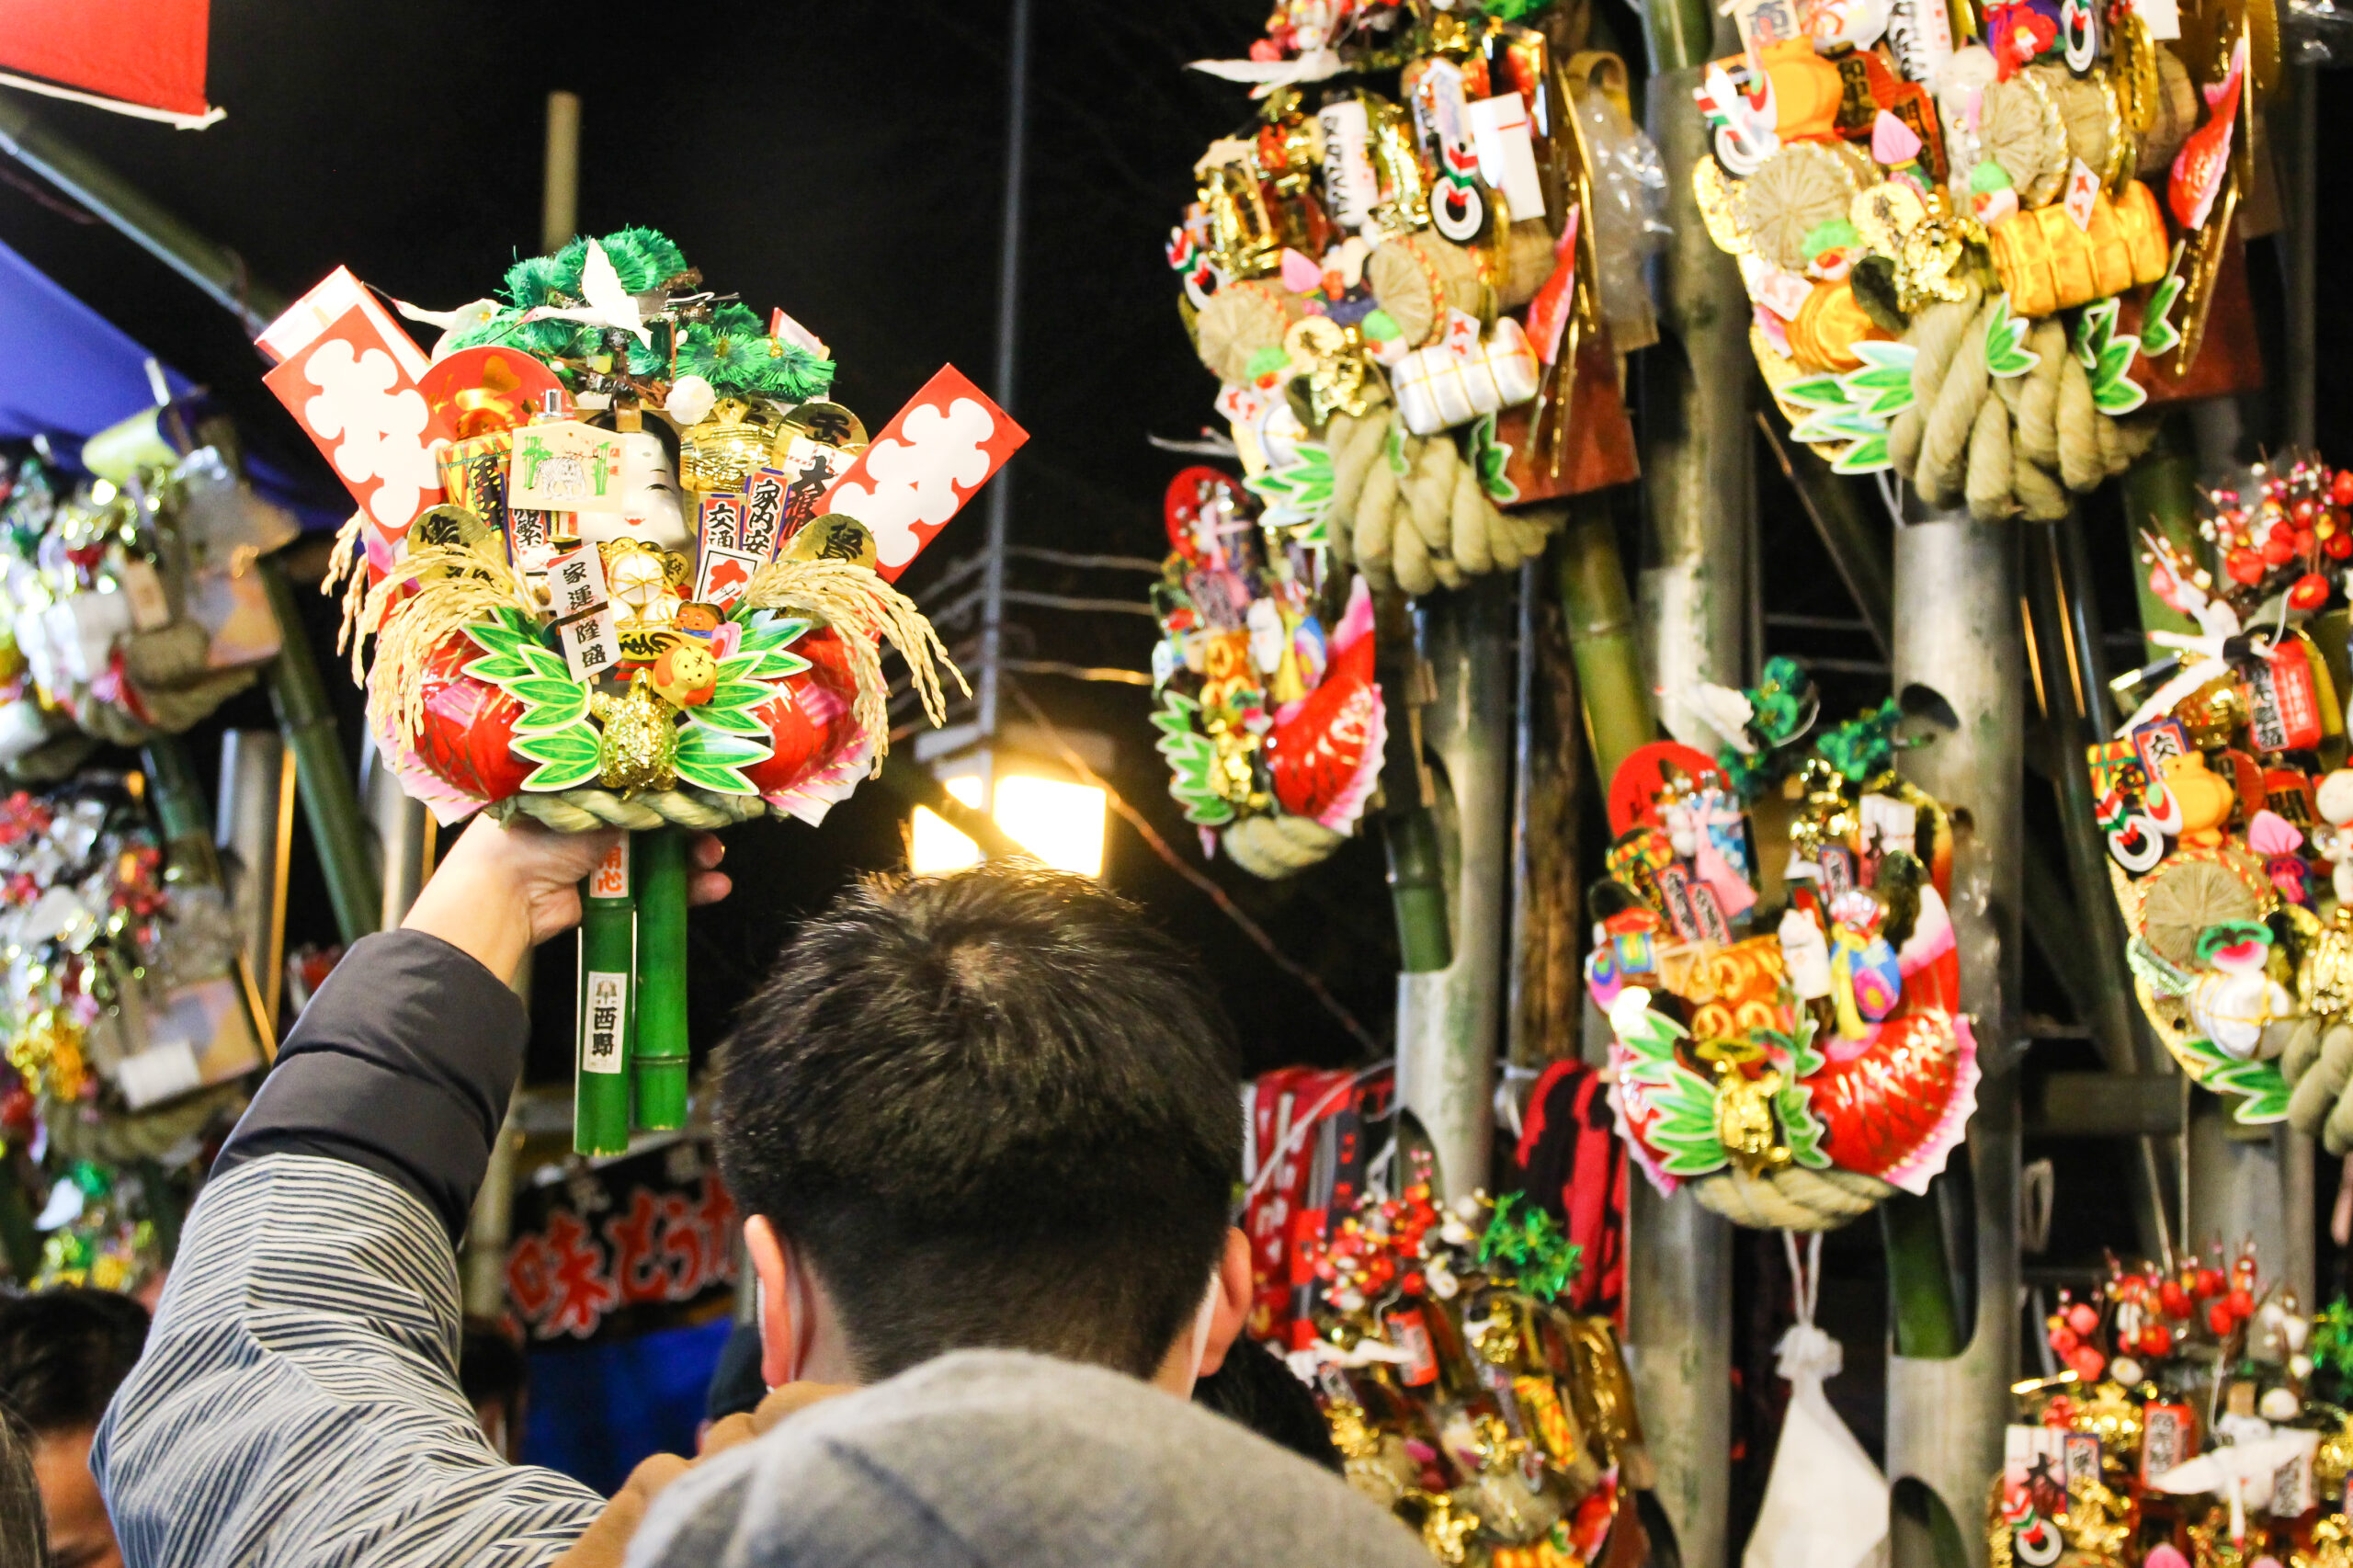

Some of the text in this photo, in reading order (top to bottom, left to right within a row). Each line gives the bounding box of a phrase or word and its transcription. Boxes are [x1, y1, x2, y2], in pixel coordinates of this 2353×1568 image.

[563, 561, 608, 668] 家運隆盛
[592, 1006, 618, 1057] 西野
